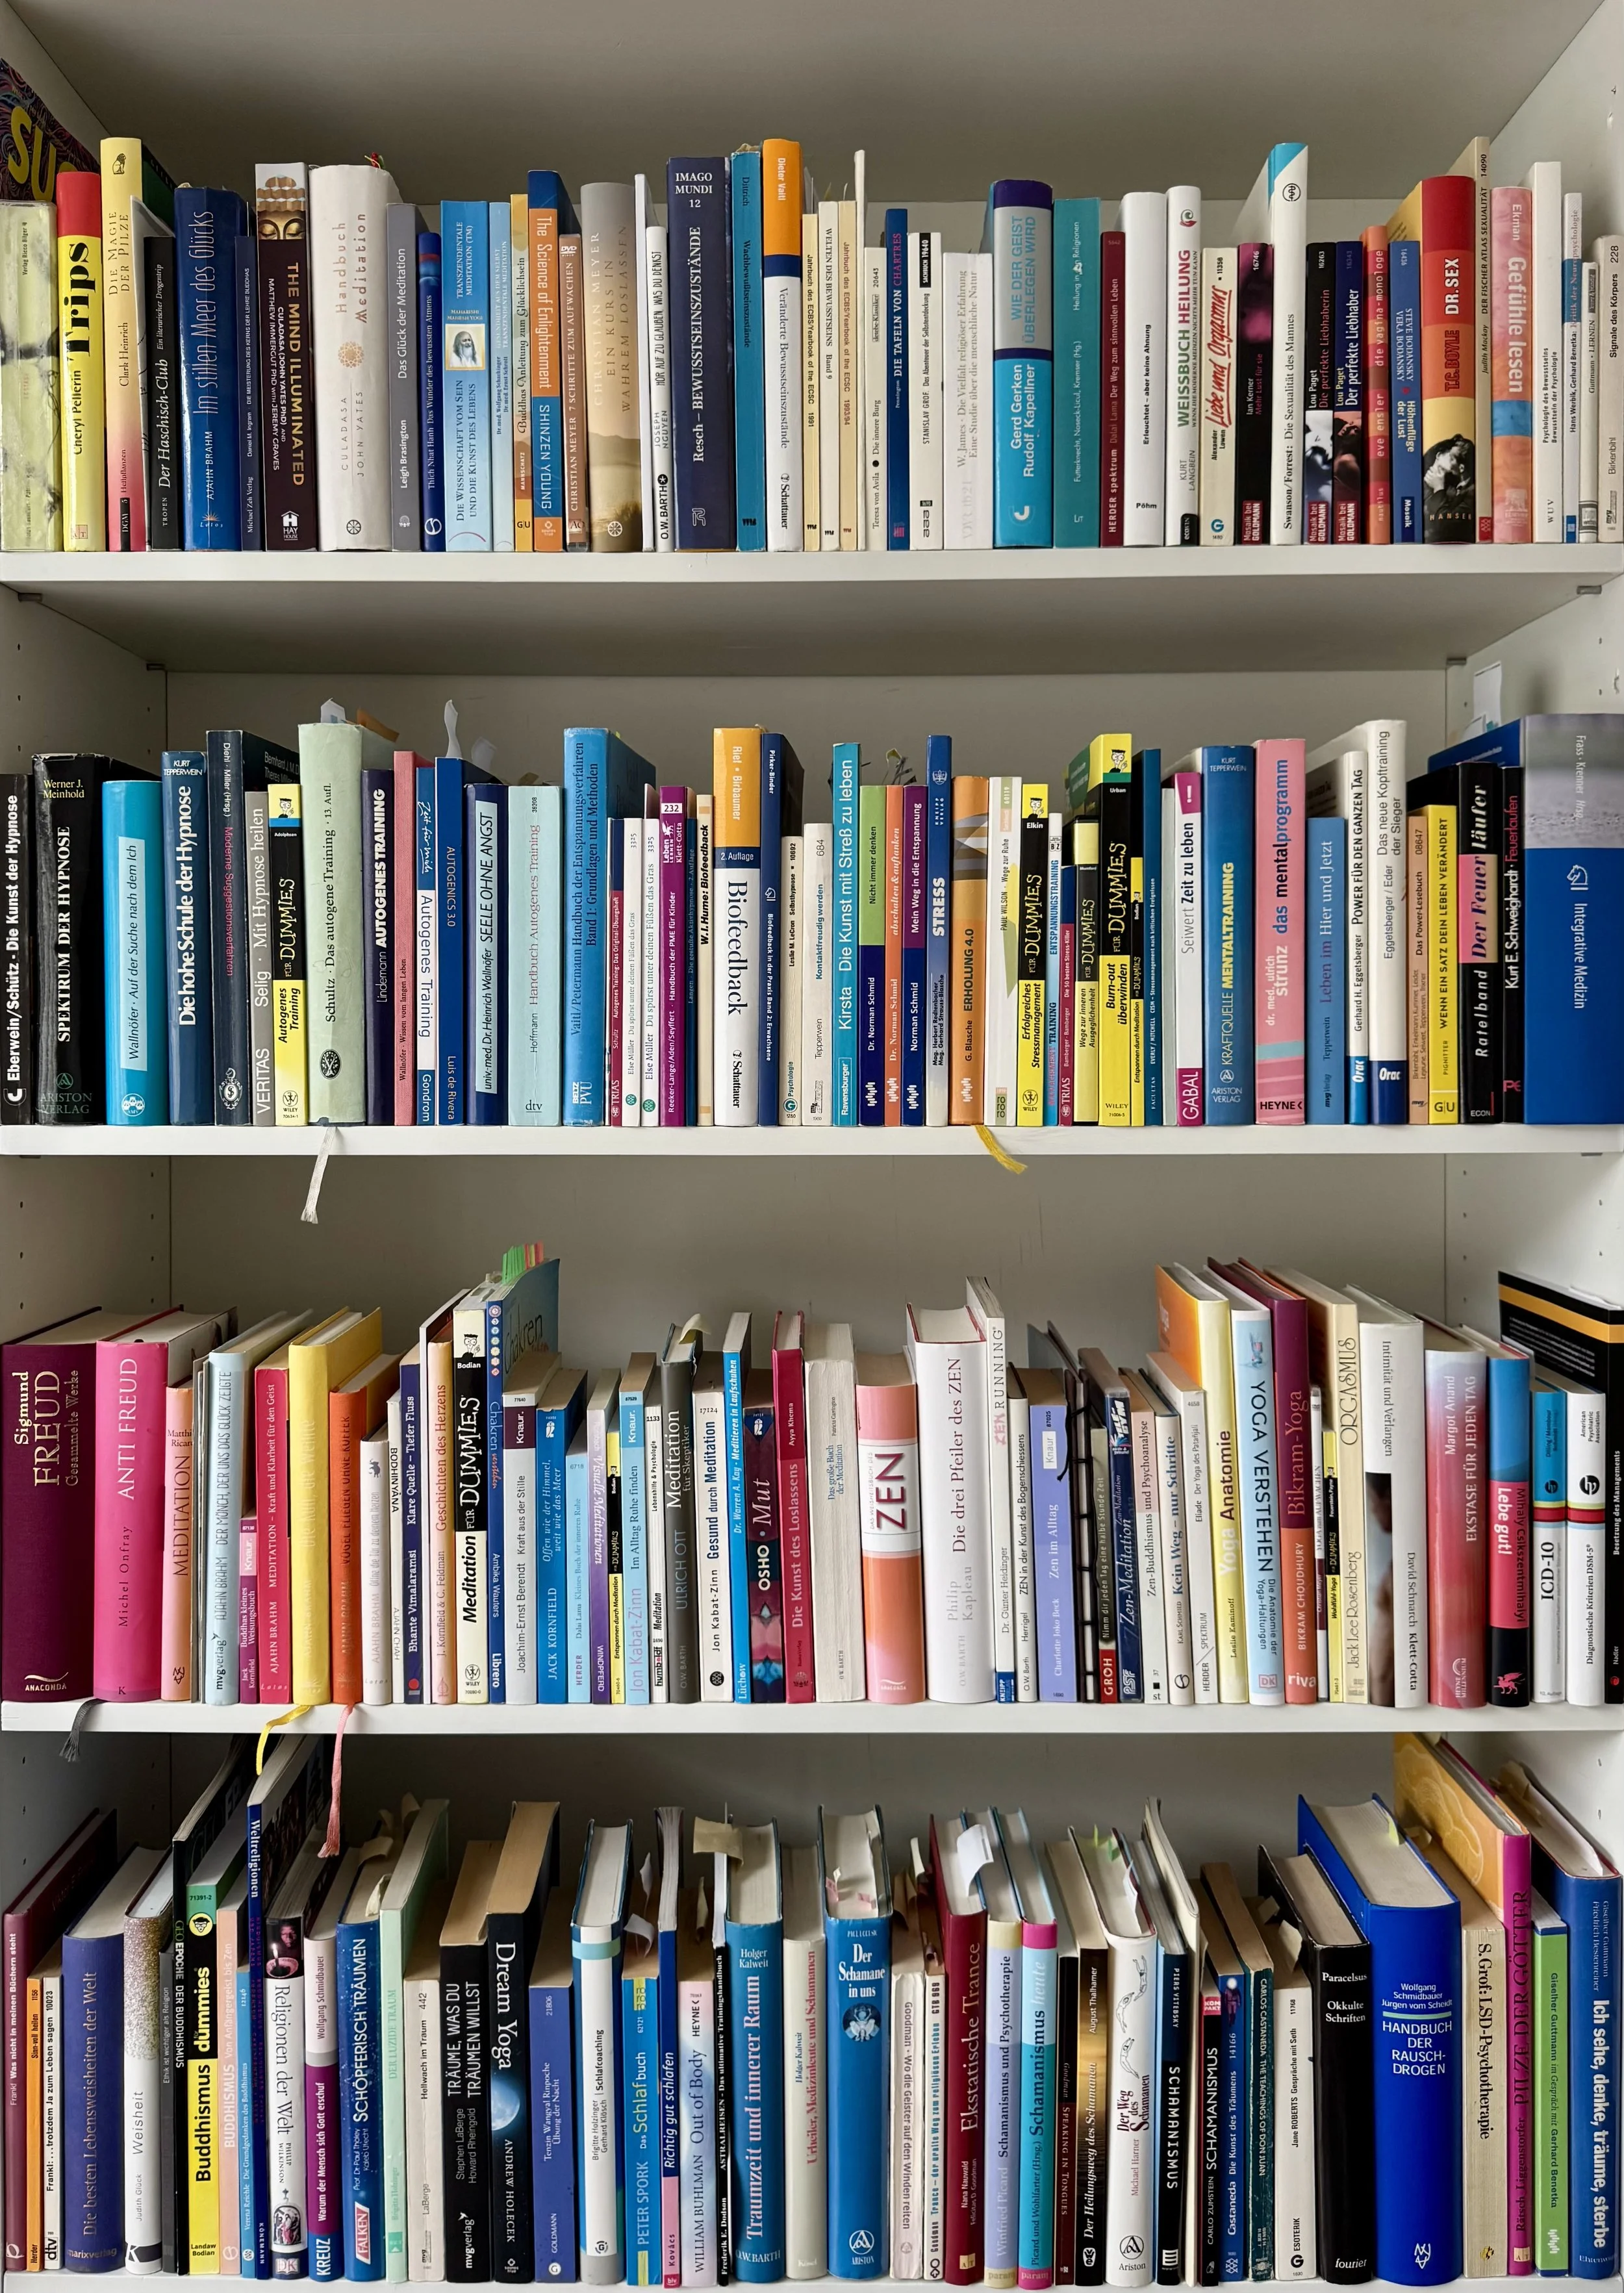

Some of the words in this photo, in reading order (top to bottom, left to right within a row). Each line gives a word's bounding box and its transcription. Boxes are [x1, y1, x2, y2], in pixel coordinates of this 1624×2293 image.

[676, 173, 712, 181] IMAGO
[676, 184, 712, 194] MUNDI
[188, 212, 214, 258] Glücks
[1512, 203, 1522, 240] Ekman
[155, 264, 164, 299] Drogentrip
[190, 267, 215, 290] des
[288, 262, 299, 297] THE
[396, 249, 405, 305] Meditation
[1178, 250, 1190, 323] HEILUNG
[1445, 259, 1458, 314] DR.SEX
[1508, 257, 1527, 335] Gefühle
[64, 243, 95, 359] Trips
[191, 299, 216, 337] Meer
[397, 308, 406, 325] der
[688, 227, 703, 410] BEWUSSTSEINSZUSTÄNDE
[289, 304, 300, 355] MIND
[397, 329, 407, 357] Glück
[188, 338, 218, 388] stillen
[398, 360, 407, 378] Das
[1178, 330, 1189, 427] WEISSBUCH
[1445, 330, 1460, 392] T.C.BOYLE
[1508, 342, 1527, 392] lesen
[71, 371, 81, 413] Pellerin
[155, 359, 170, 461] Haschisch-Club
[188, 396, 218, 416] Im
[1011, 365, 1022, 412] Gerken
[1024, 364, 1035, 427] Kapellner
[73, 419, 84, 455] Cheryl
[289, 359, 304, 485] ILLUMINATED
[400, 420, 409, 464] Brasington
[540, 405, 550, 459] SHINZEN
[692, 424, 704, 462] Resch
[1011, 417, 1022, 449] Gerd
[159, 464, 170, 488] Der
[400, 466, 409, 488] Leigh
[1024, 433, 1034, 476] Rudolf
[541, 464, 552, 509] YOUNG
[282, 525, 299, 535] HAY
[44, 779, 75, 788] Werner
[77, 779, 82, 790] J.
[44, 789, 84, 798] Meinhold
[663, 803, 681, 812] 232
[58, 827, 70, 906] HYPNOSE
[721, 852, 727, 861] 2.
[728, 852, 754, 861] Auflage
[58, 912, 70, 944] DER
[933, 878, 945, 936] STRESS
[1222, 863, 1234, 989] MENTALTRAINING
[418, 896, 433, 973] Autogenes
[728, 881, 748, 1015] Biofeedback
[1573, 904, 1588, 963] Integrative
[58, 953, 70, 1041] SPEKTRUM
[418, 980, 433, 1039] Training
[1106, 963, 1115, 1009] Burn-out
[1118, 964, 1127, 1024] überwinden
[1575, 966, 1588, 1008] Medizin
[1022, 983, 1032, 1039] Erfolgreiches
[1031, 983, 1042, 1068] Stressmanagement
[1222, 993, 1233, 1064] KRAFTQUELLE
[1474, 970, 1488, 1057] Ratelband
[254, 1048, 271, 1116] VERITAS
[423, 1074, 431, 1121] Gondrom
[1182, 1072, 1199, 1119] GABAL
[119, 1359, 136, 1432] FREUD
[948, 1359, 961, 1393] ZEN
[1339, 1336, 1359, 1445] ORGASMUS
[13, 1371, 31, 1444] Sigmund
[33, 1371, 60, 1486] FREUD
[948, 1400, 962, 1425] des
[1251, 1380, 1275, 1441] YOGA
[118, 1445, 135, 1500] ANTI
[460, 1395, 481, 1506] DUMMIES
[665, 1411, 683, 1508] Meditation
[705, 1420, 717, 1482] Meditation
[949, 1431, 963, 1481] Pfeiler
[1286, 1391, 1308, 1514] Bikram-Yoga
[875, 1453, 907, 1532] ZEN
[1220, 1429, 1236, 1520] Anatomie
[173, 1456, 190, 1576] MEDITATION
[708, 1488, 718, 1513] durch
[752, 1478, 771, 1526] Mut
[951, 1489, 964, 1519] drei
[1254, 1450, 1273, 1571] VERSTEHEN
[1498, 1488, 1512, 1521] Lebe
[705, 1514, 718, 1560] Gesund
[953, 1526, 965, 1552] Die
[1494, 1524, 1512, 1554] gut!
[462, 1536, 476, 1623] Meditation
[757, 1545, 770, 1590] OSHO
[1541, 1542, 1554, 1600] ICD-10
[492, 1653, 501, 1688] Librero
[1104, 1658, 1113, 1696] GROH
[1288, 1673, 1317, 1688] riva
[249, 1819, 260, 1897] Weltreligionen
[351, 1939, 370, 2010] TRÄUMEN
[739, 1958, 768, 1968] Kalweit
[741, 1949, 767, 1959] Holger
[839, 1961, 885, 1981] Schamane
[851, 1944, 872, 1962] Der
[496, 1942, 515, 2014] Dream
[849, 1983, 857, 1997] in
[860, 1987, 876, 1997] uns
[962, 1944, 980, 2014] Trance
[1322, 1972, 1367, 1982] Paracelsus
[1393, 1991, 1442, 1999] Schmidbauer
[1401, 1983, 1436, 1992] Wolfgang
[195, 1967, 210, 2051] dummies
[273, 1986, 292, 2064] Religionen
[744, 1976, 759, 2028] Raum
[1326, 2013, 1365, 2022] Schriften
[1327, 2001, 1364, 2010] Okkulte
[1381, 2000, 1407, 2010] Jürgen
[1428, 1999, 1453, 2008] Scheidt
[1593, 2000, 1609, 2023] Ich
[492, 2020, 517, 2070] Yoga
[1383, 2021, 1451, 2034] HANDBUCH
[1408, 2038, 1432, 2048] DER
[1591, 2029, 1609, 2070] sehe,
[351, 2011, 370, 2122] SCHÖPFERISCH
[744, 2033, 761, 2101] innerer
[960, 2017, 979, 2132] Ekstatische
[1030, 2010, 1045, 2135] Schamanismus
[1392, 2049, 1445, 2062] RAUSCH-
[1393, 2063, 1445, 2075] DROGEN
[1477, 1997, 1491, 2139] LSD-Psychotherapie
[277, 2071, 293, 2096] der
[1591, 2074, 1609, 2125] denke,
[133, 2092, 143, 2154] Weisheit
[195, 2065, 210, 2181] Buddhismus
[277, 2101, 294, 2135] Welt
[744, 2107, 761, 2141] und
[1206, 2048, 1217, 2170] SCHAMANISMUS
[1591, 2130, 1609, 2192] träume,
[746, 2147, 763, 2240] Traumzeit
[357, 2213, 368, 2253] FALKEN
[1594, 2196, 1609, 2248] sterbe
[316, 2238, 331, 2275] KREUZ
[1336, 2259, 1367, 2268] fourier
